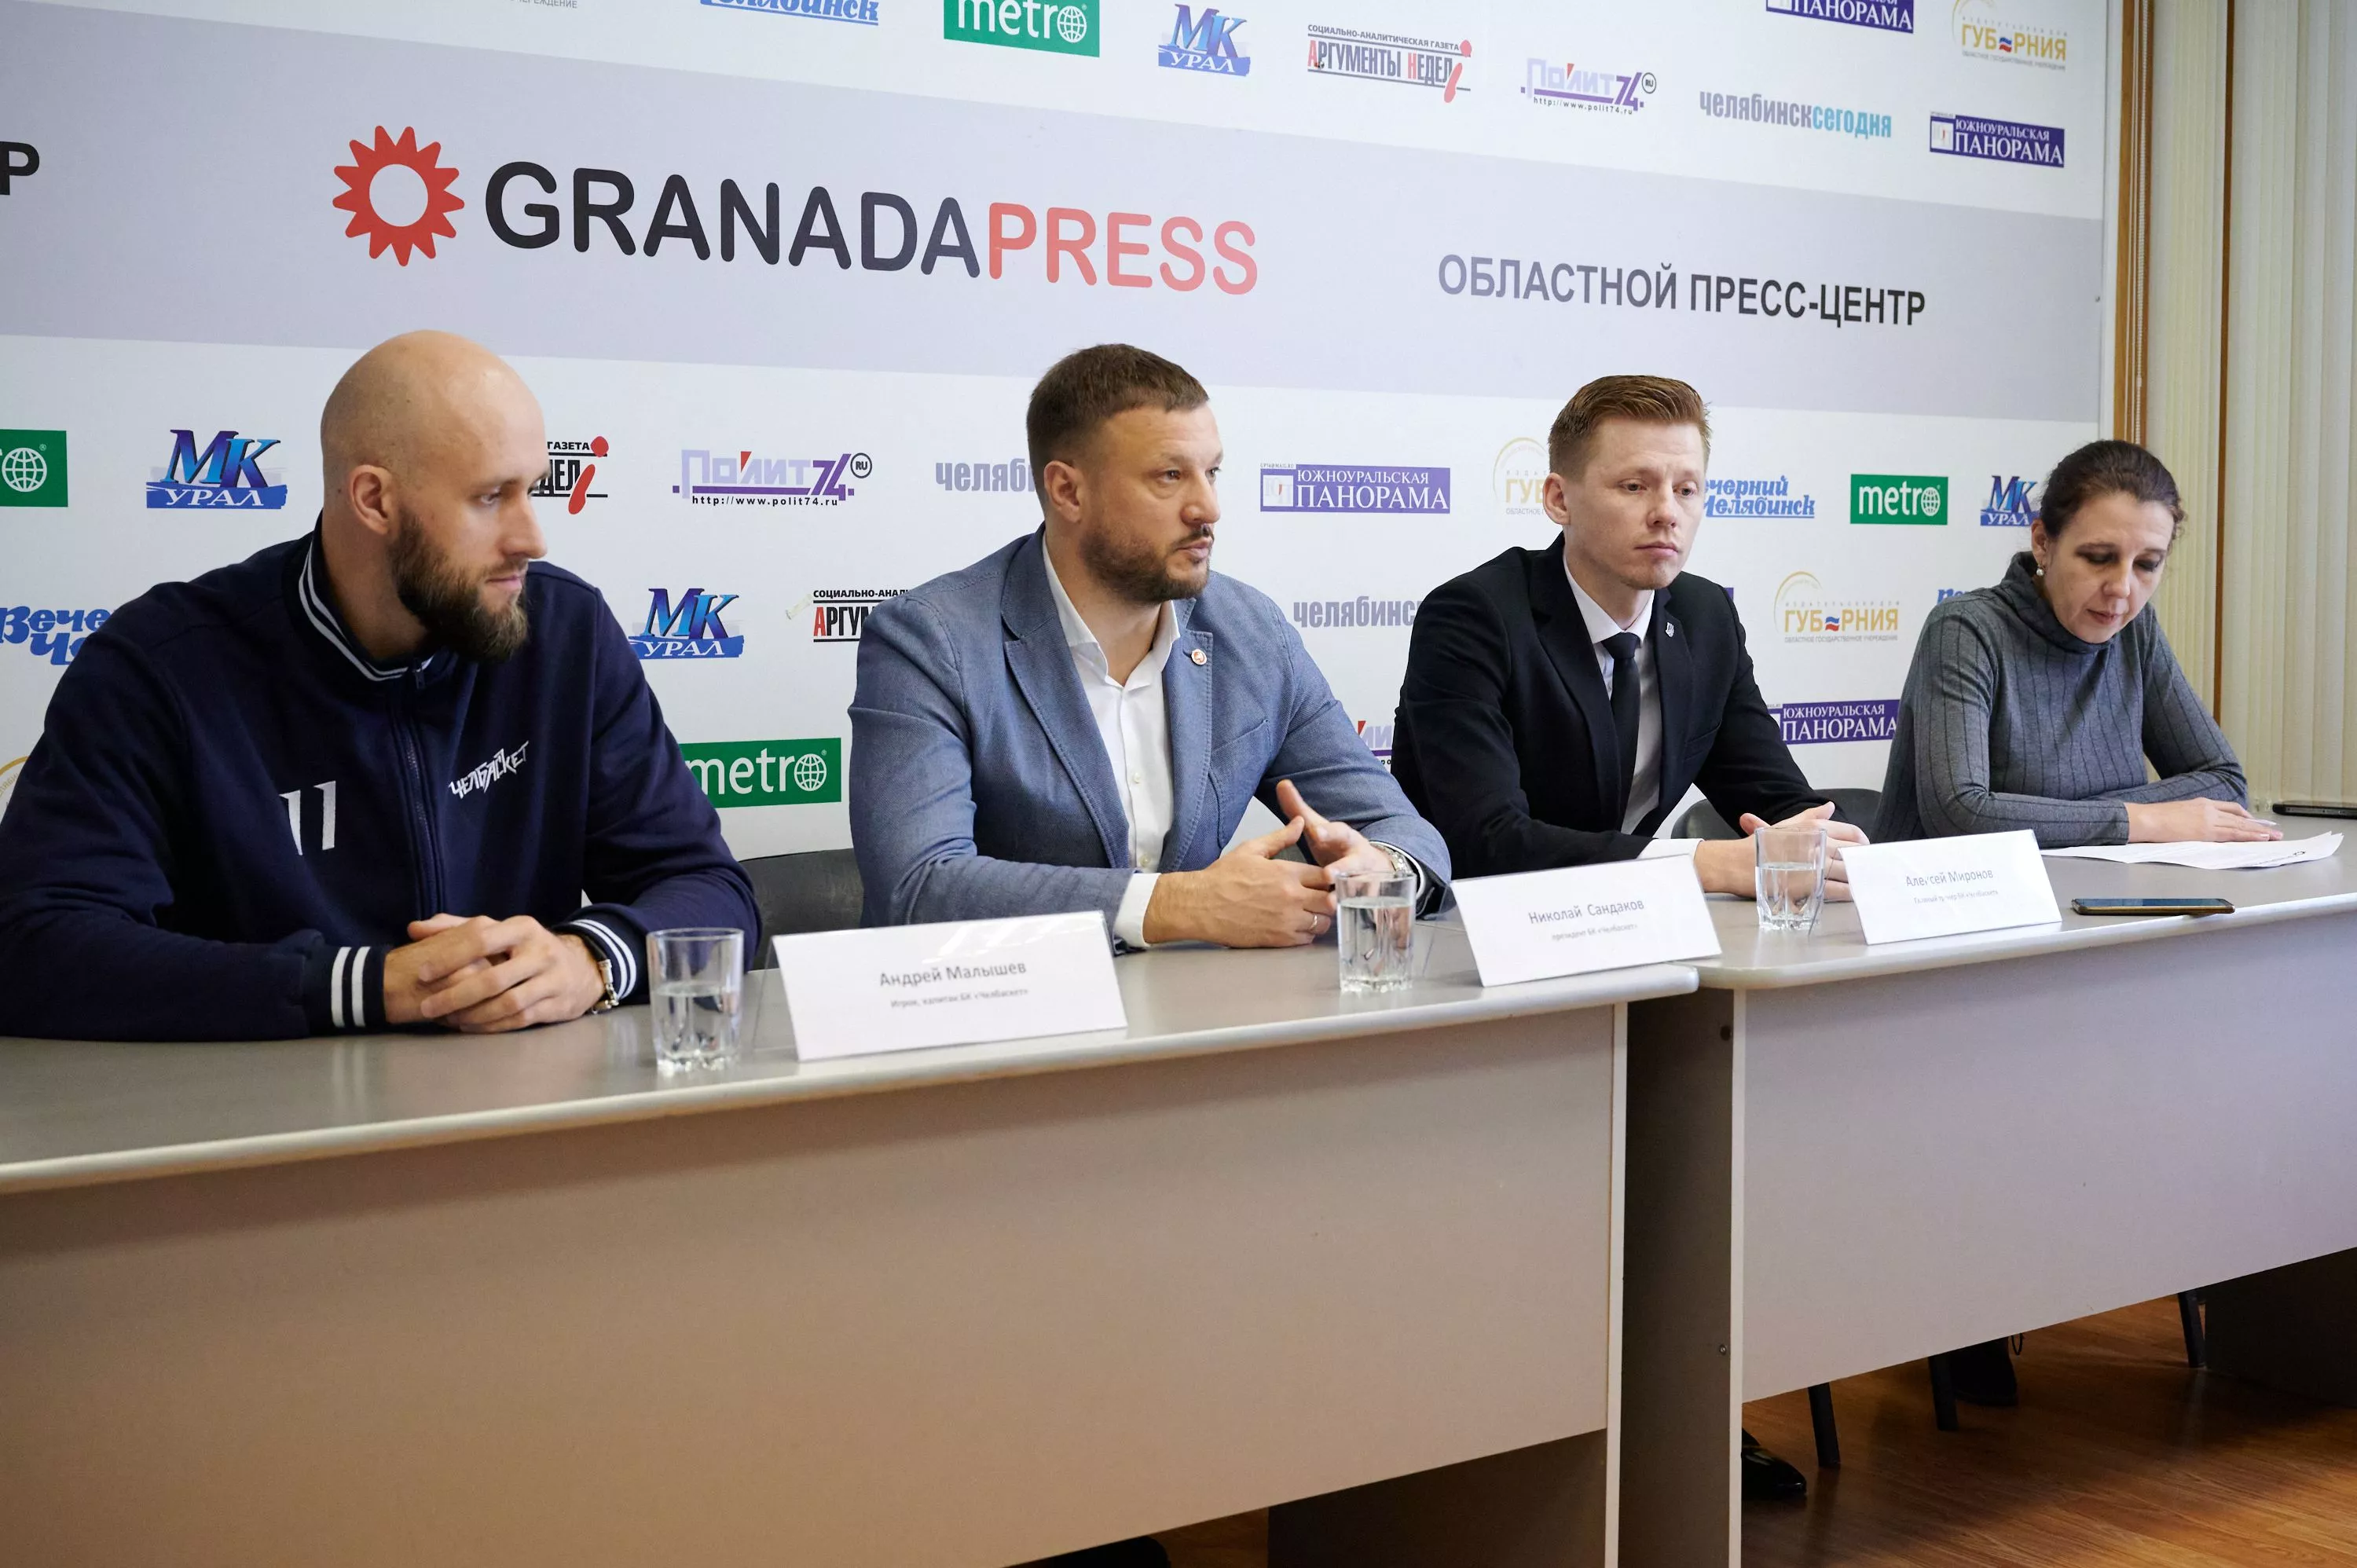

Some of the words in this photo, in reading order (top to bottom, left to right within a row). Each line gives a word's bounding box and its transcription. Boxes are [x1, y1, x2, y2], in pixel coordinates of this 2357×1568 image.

[958, 0, 1087, 42] metro
[1794, 0, 1912, 30] ПАНОРАМА
[1170, 3, 1248, 57] МК
[1307, 24, 1429, 47] СОЦИАЛЬНО-АНАЛИТИЧЕСКАЯ
[1430, 40, 1460, 51] ГАЗЕТА
[1171, 50, 1237, 73] УРАЛ
[1307, 39, 1401, 78] АРГУМЕНТЫ
[1534, 97, 1633, 115] http://www.polit74.ru
[1956, 119, 2049, 141] ЮЖНОУРАЛЬСКАЯ
[1955, 132, 2063, 164] ПАНОРАМА
[485, 161, 1258, 295] GRANADAPRESS
[1438, 254, 1677, 310] ОБЛАСТНОЙ
[1691, 274, 1926, 328] ПРЕСС-ЦЕНТР
[159, 429, 281, 488] МК
[547, 441, 590, 450] ГАЗЕТА
[855, 461, 868, 470] RU
[1298, 470, 1429, 485] ЮЖНОУРАЛЬСКАЯ
[165, 489, 265, 507] УРАЛ
[692, 496, 838, 507] http://www.polit74.ru
[1296, 485, 1449, 510] ПАНОРАМА
[1859, 481, 1941, 516] metro
[1986, 475, 2037, 513] МК
[1987, 513, 2030, 526] УРАЛ
[643, 588, 739, 639] МК
[1293, 596, 1424, 628] челябинс
[644, 640, 725, 657] УРАЛ
[1783, 704, 1885, 719] ЮЖНОУРАЛЬСКАЯ
[1783, 716, 1897, 742] ПАНОРАМА
[685, 748, 827, 795] metro
[278, 780, 336, 855] 11
[1948, 870, 1993, 883] Миронов
[1528, 905, 1582, 924] Николай
[1587, 900, 1644, 916] Сандаков
[880, 967, 943, 987] Андрей
[946, 962, 1027, 980] Малышев
